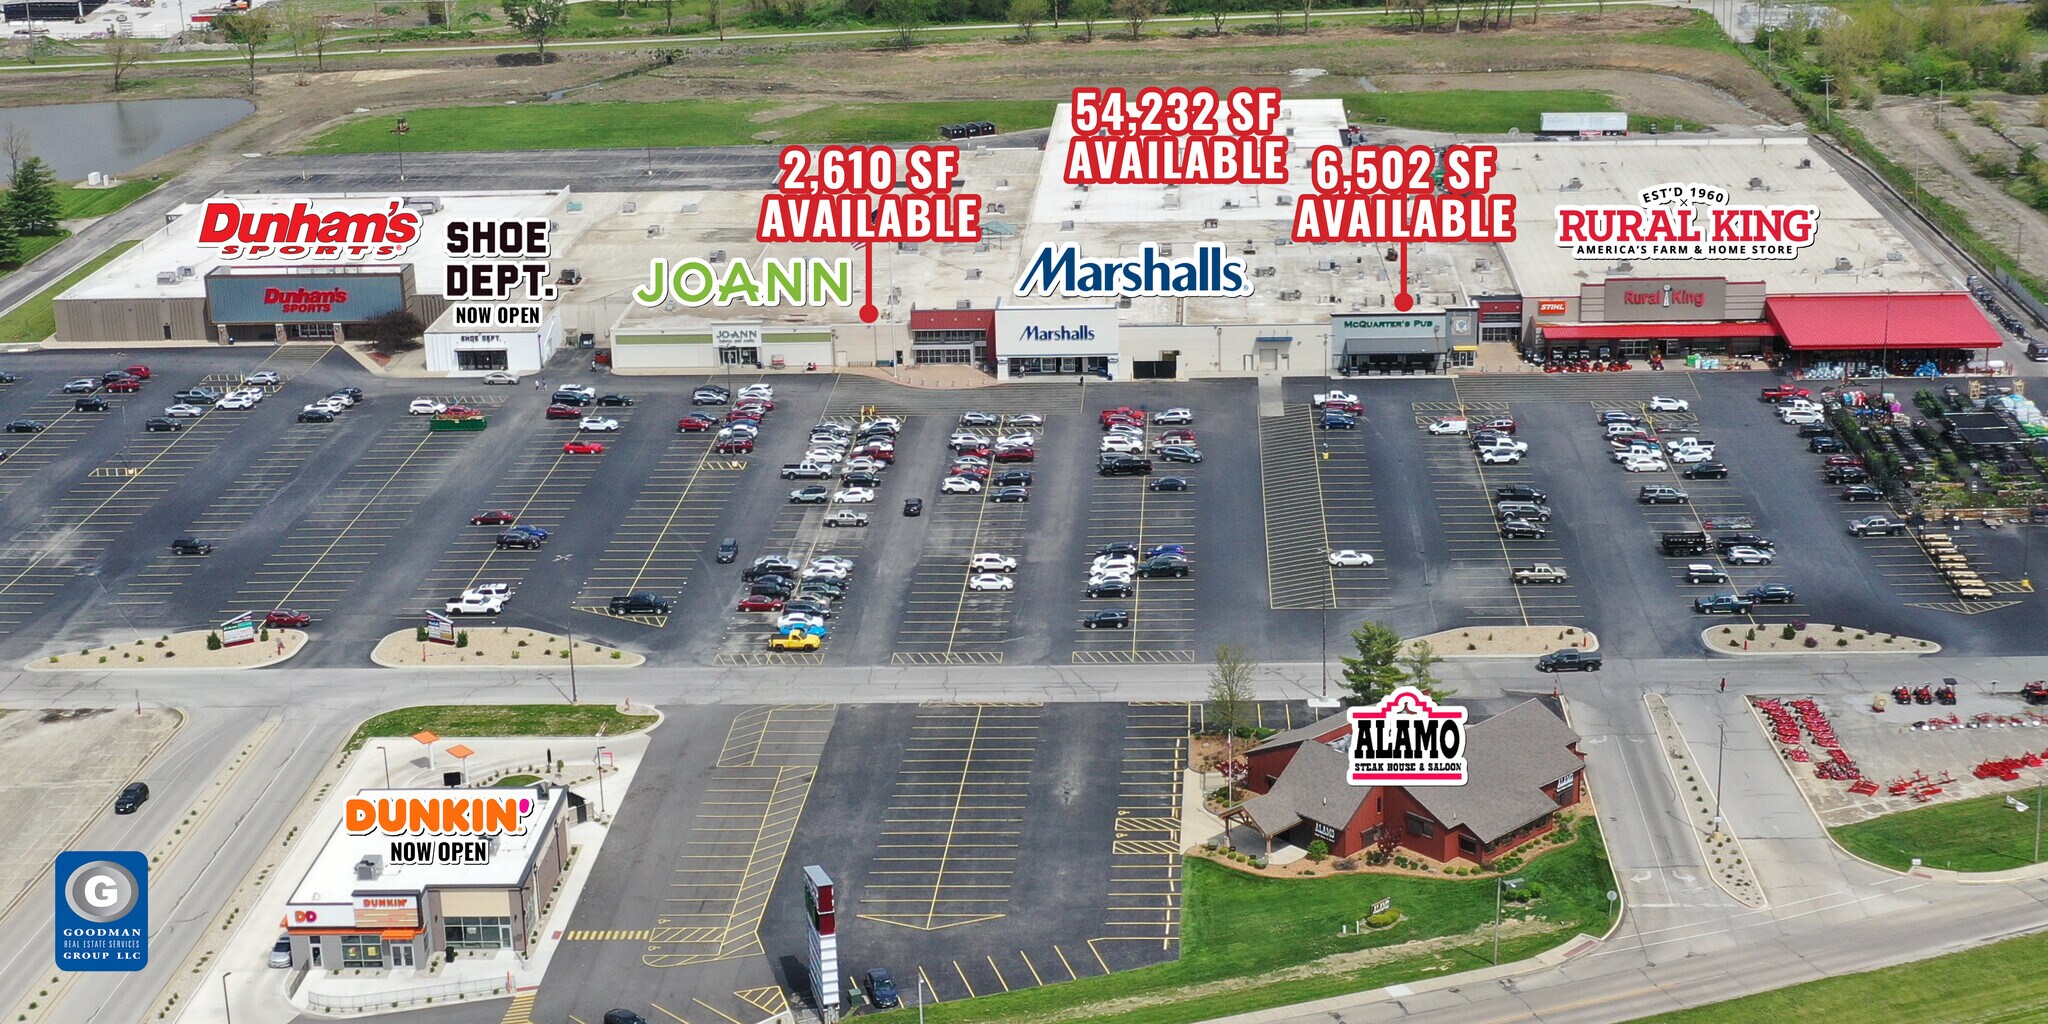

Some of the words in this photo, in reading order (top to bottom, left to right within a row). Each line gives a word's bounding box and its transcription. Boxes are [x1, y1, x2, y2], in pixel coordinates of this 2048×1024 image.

[263, 287, 347, 305] Dunham's
[1625, 290, 1660, 305] Rural
[1672, 290, 1704, 306] King
[282, 304, 332, 313] SPORTS
[1019, 325, 1095, 342] Marshalls
[295, 910, 317, 922] DD
